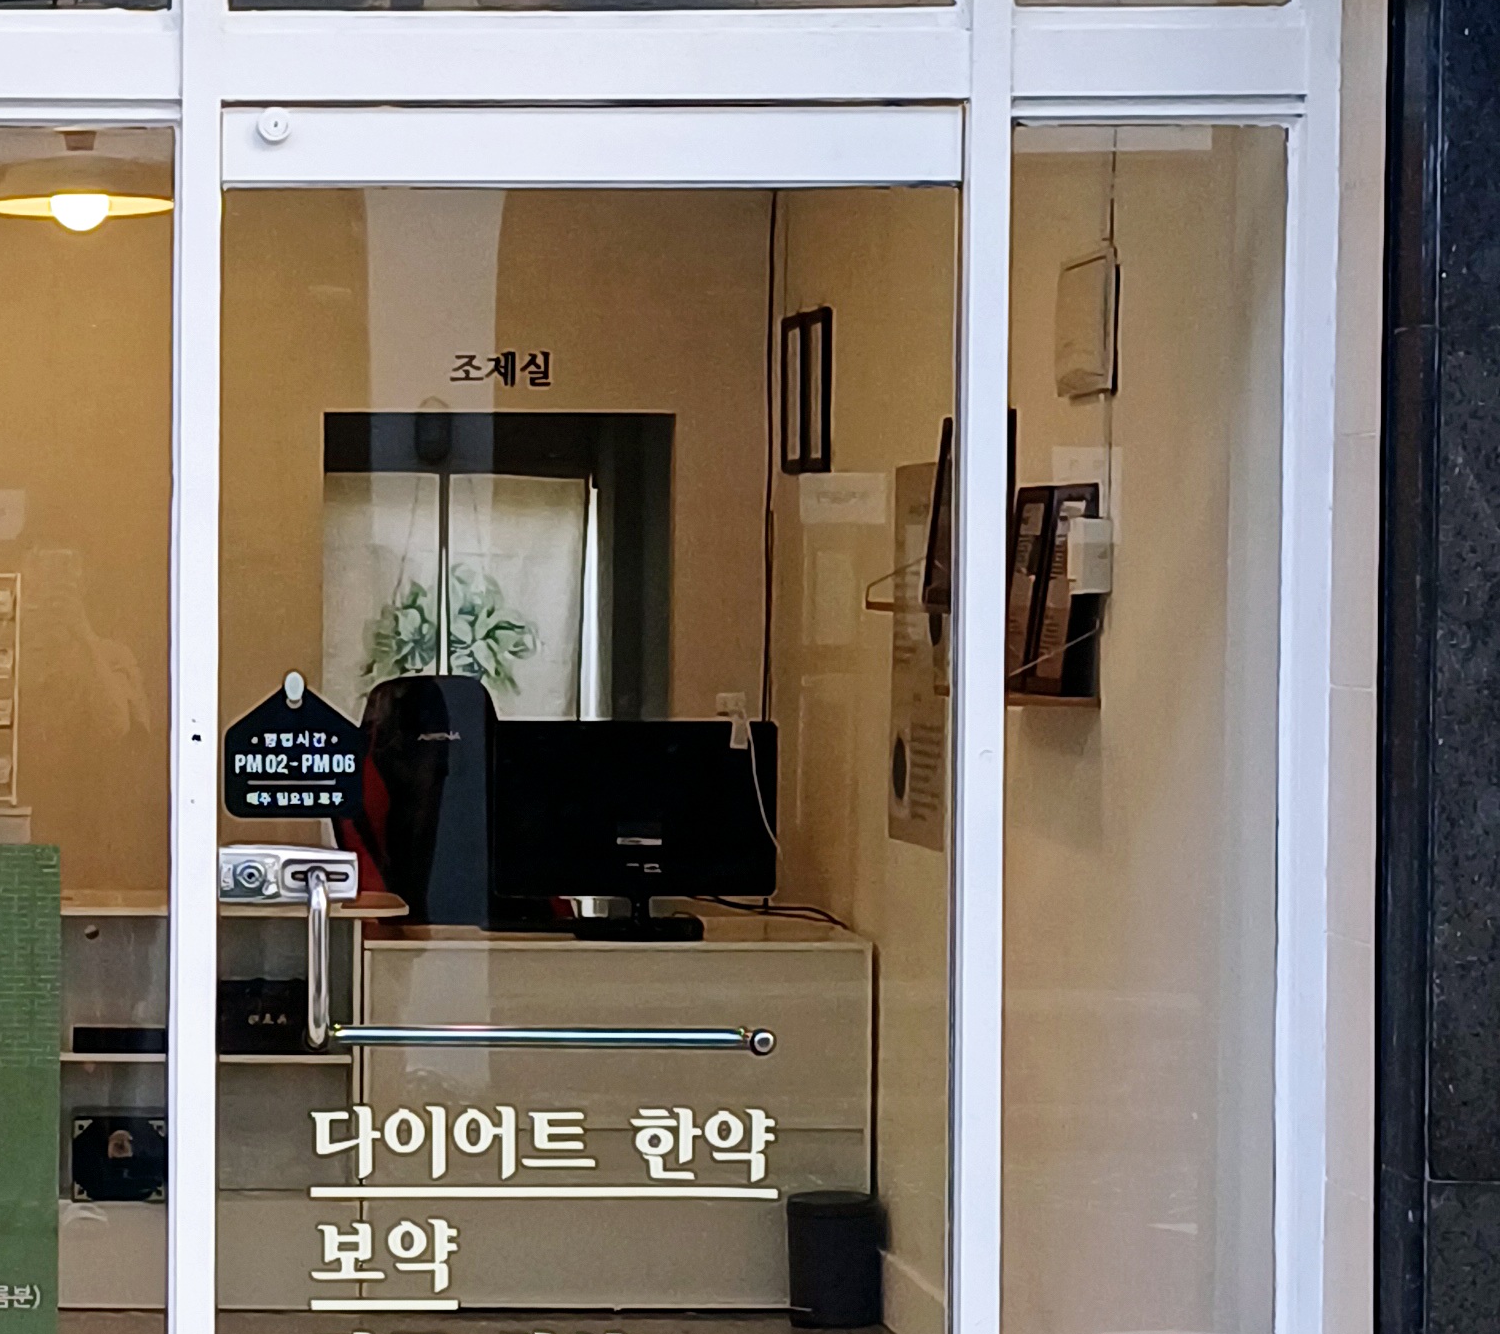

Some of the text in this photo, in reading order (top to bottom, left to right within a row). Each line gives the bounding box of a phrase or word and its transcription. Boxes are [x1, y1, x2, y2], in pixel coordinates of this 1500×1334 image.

[449, 350, 552, 388] 조제실
[310, 1106, 775, 1182] 다이어트 한약
[310, 1219, 459, 1293] 보약
